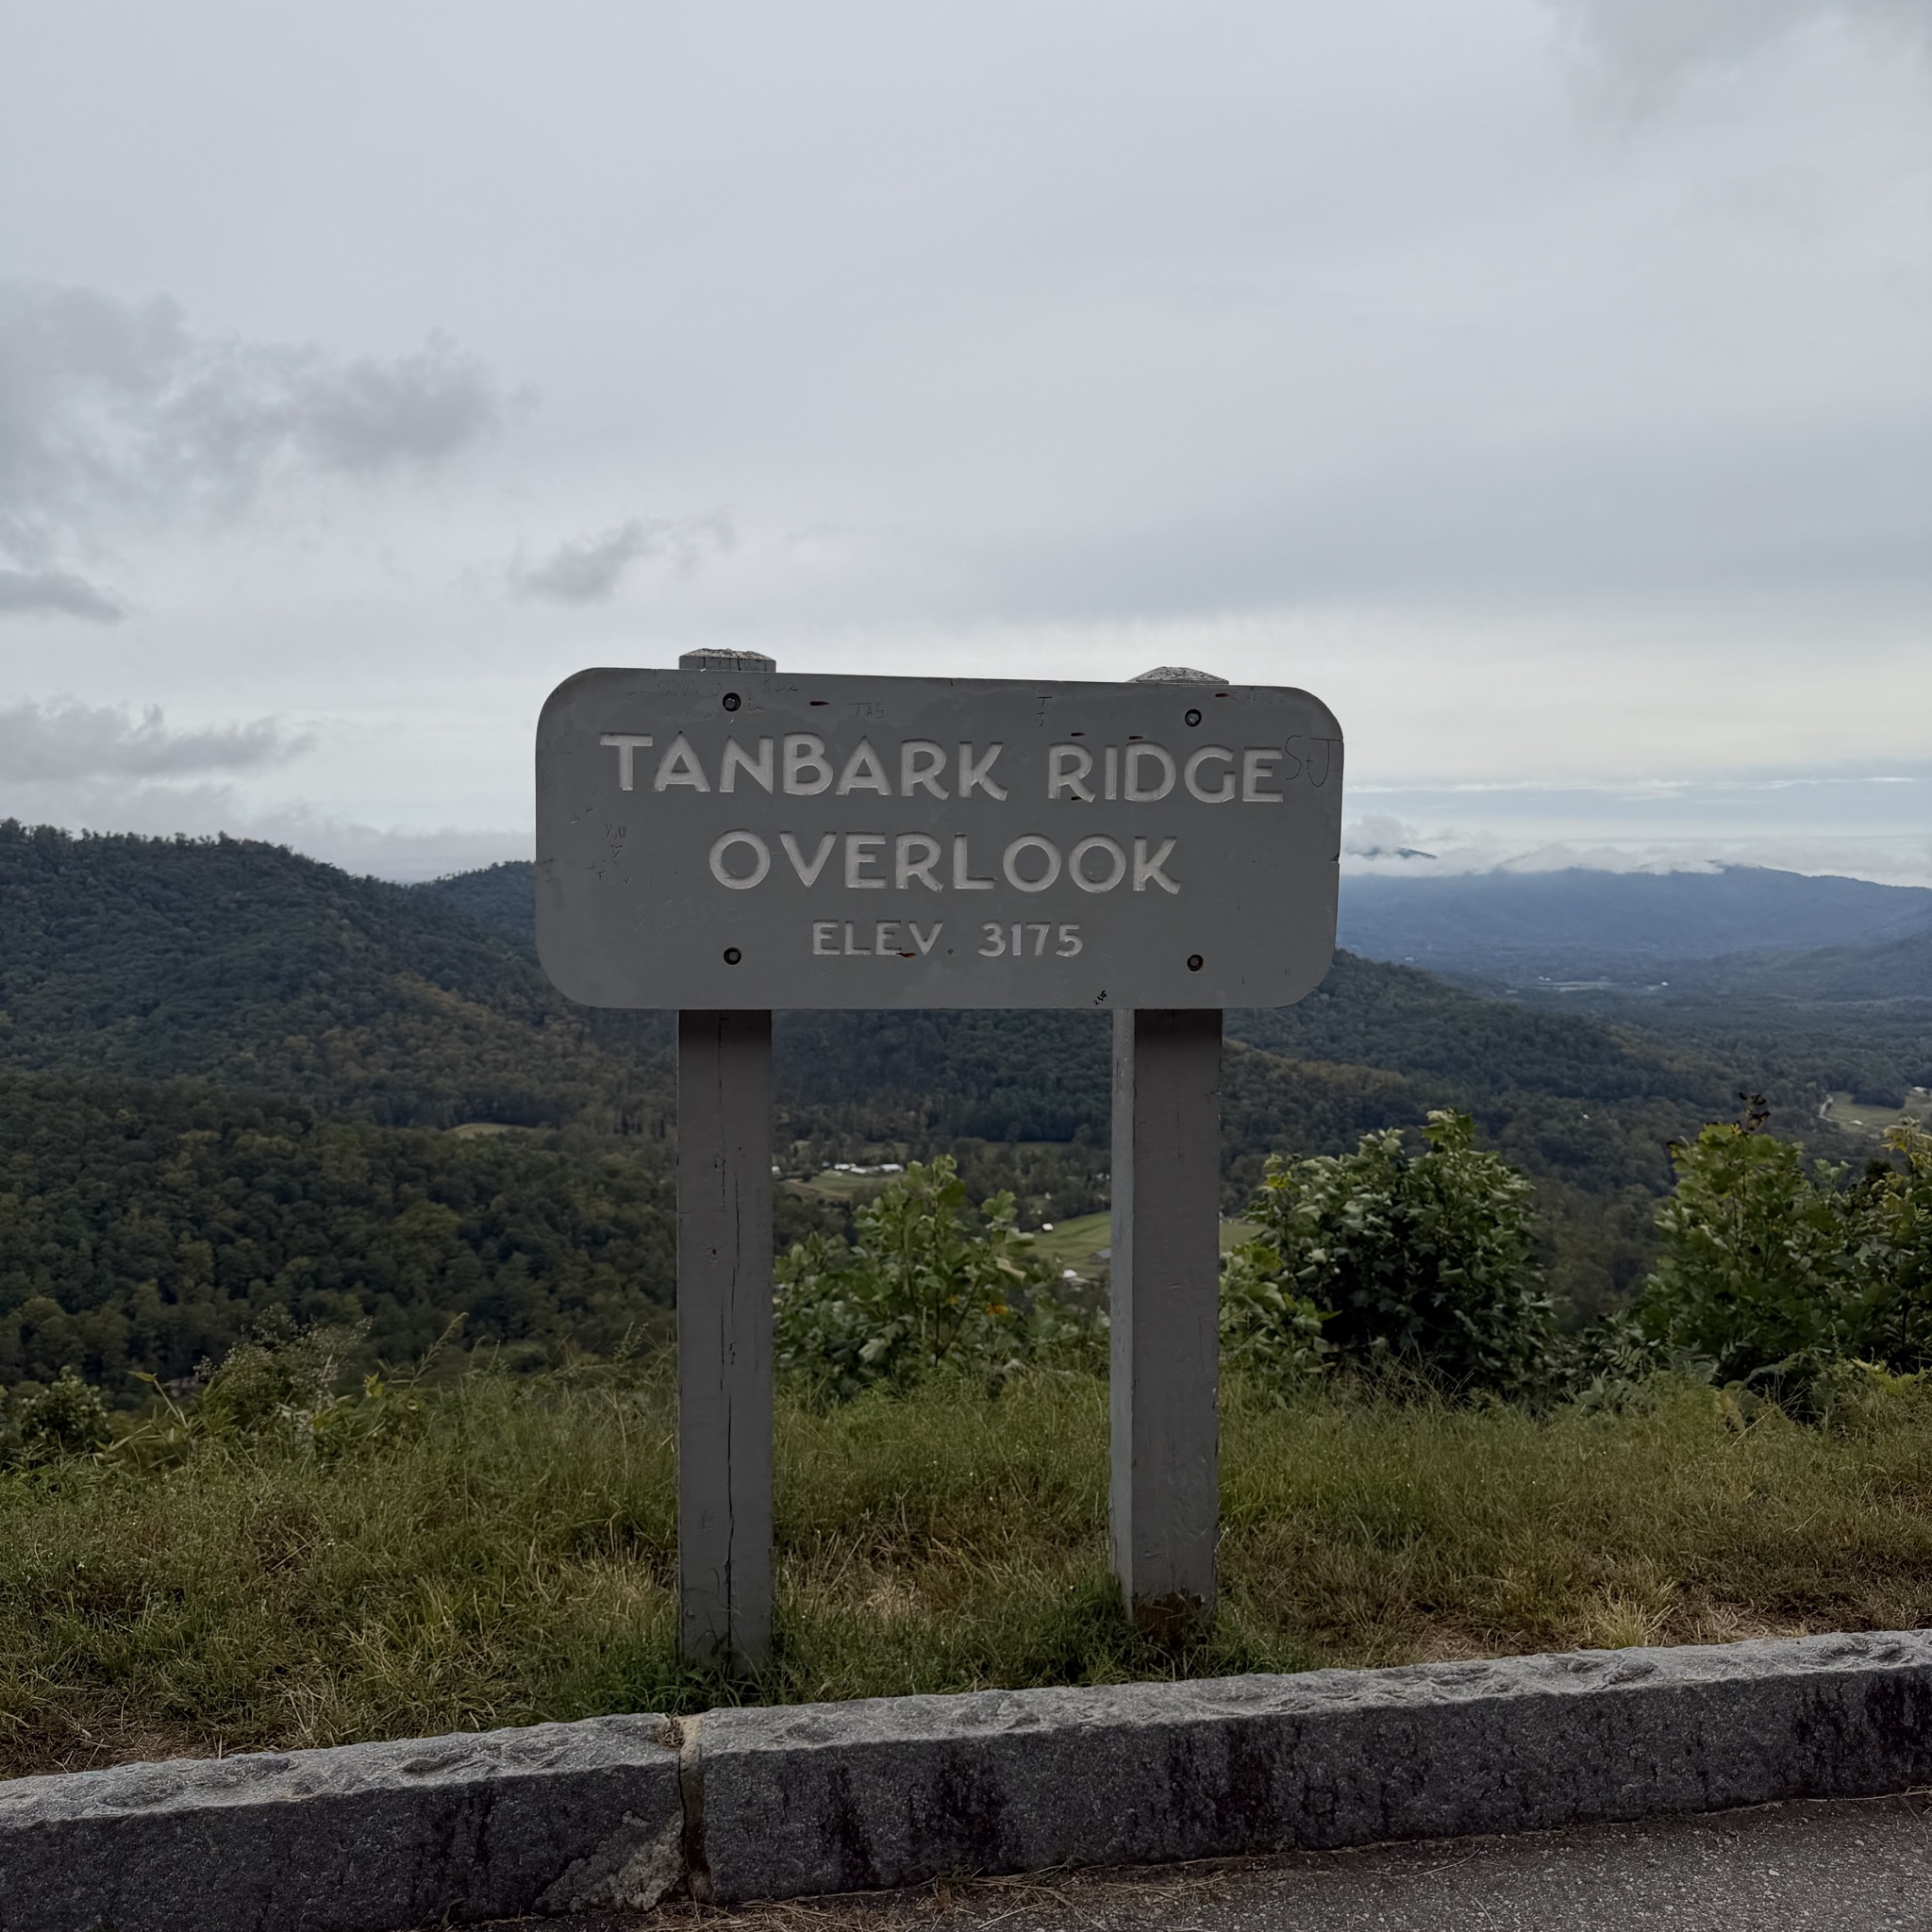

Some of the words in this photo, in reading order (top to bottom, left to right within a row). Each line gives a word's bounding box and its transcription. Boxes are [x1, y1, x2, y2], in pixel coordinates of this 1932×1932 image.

[600, 733, 1008, 802] TANBARK
[1047, 741, 1285, 804] RIDGE
[708, 830, 1182, 895] OVERLOOK
[978, 923, 1084, 958] 3175
